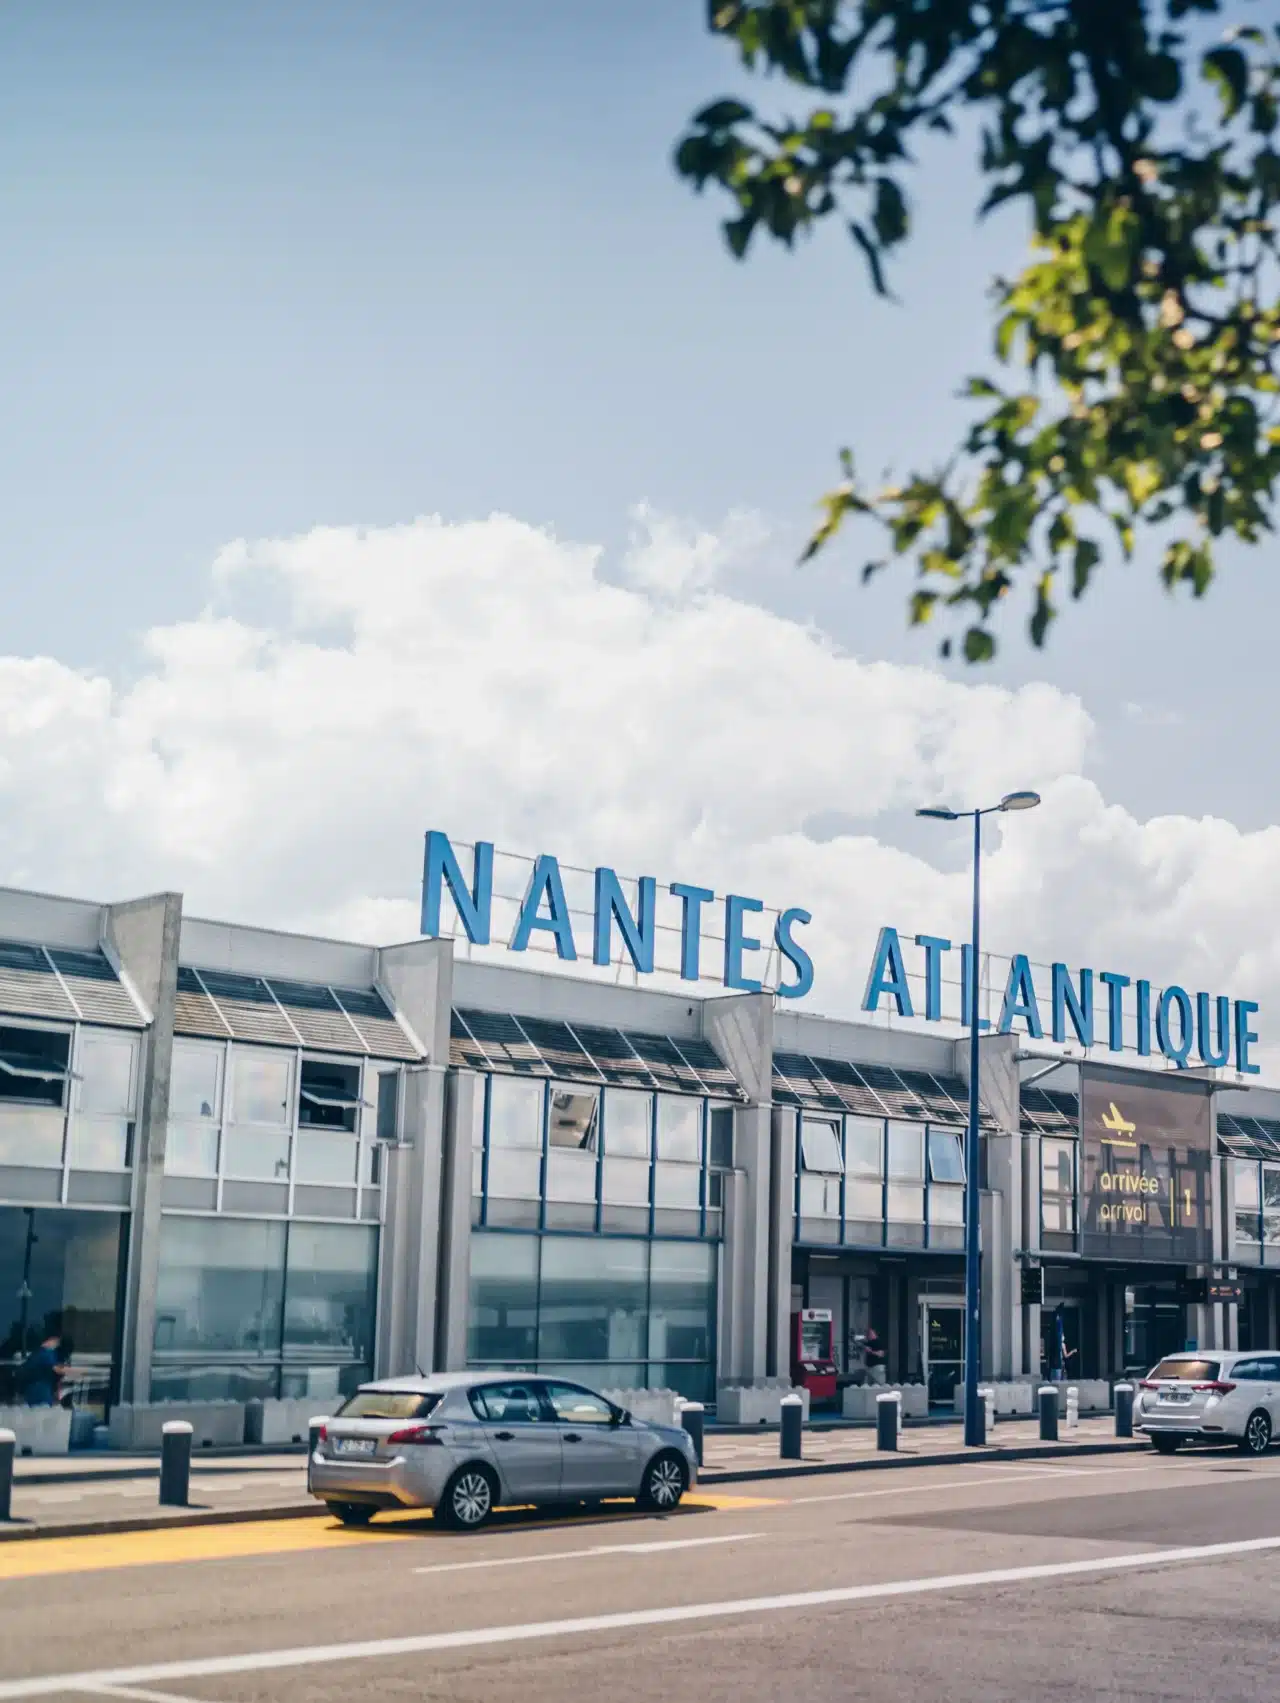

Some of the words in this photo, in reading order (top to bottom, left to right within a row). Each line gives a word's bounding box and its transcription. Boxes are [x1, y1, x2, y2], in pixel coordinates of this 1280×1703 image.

[421, 830, 814, 998] NANTES
[861, 926, 1260, 1074] ATLANTIQUE
[1100, 1169, 1159, 1194] arrivée
[1100, 1199, 1147, 1222] arrival
[1184, 1188, 1191, 1216] 1
